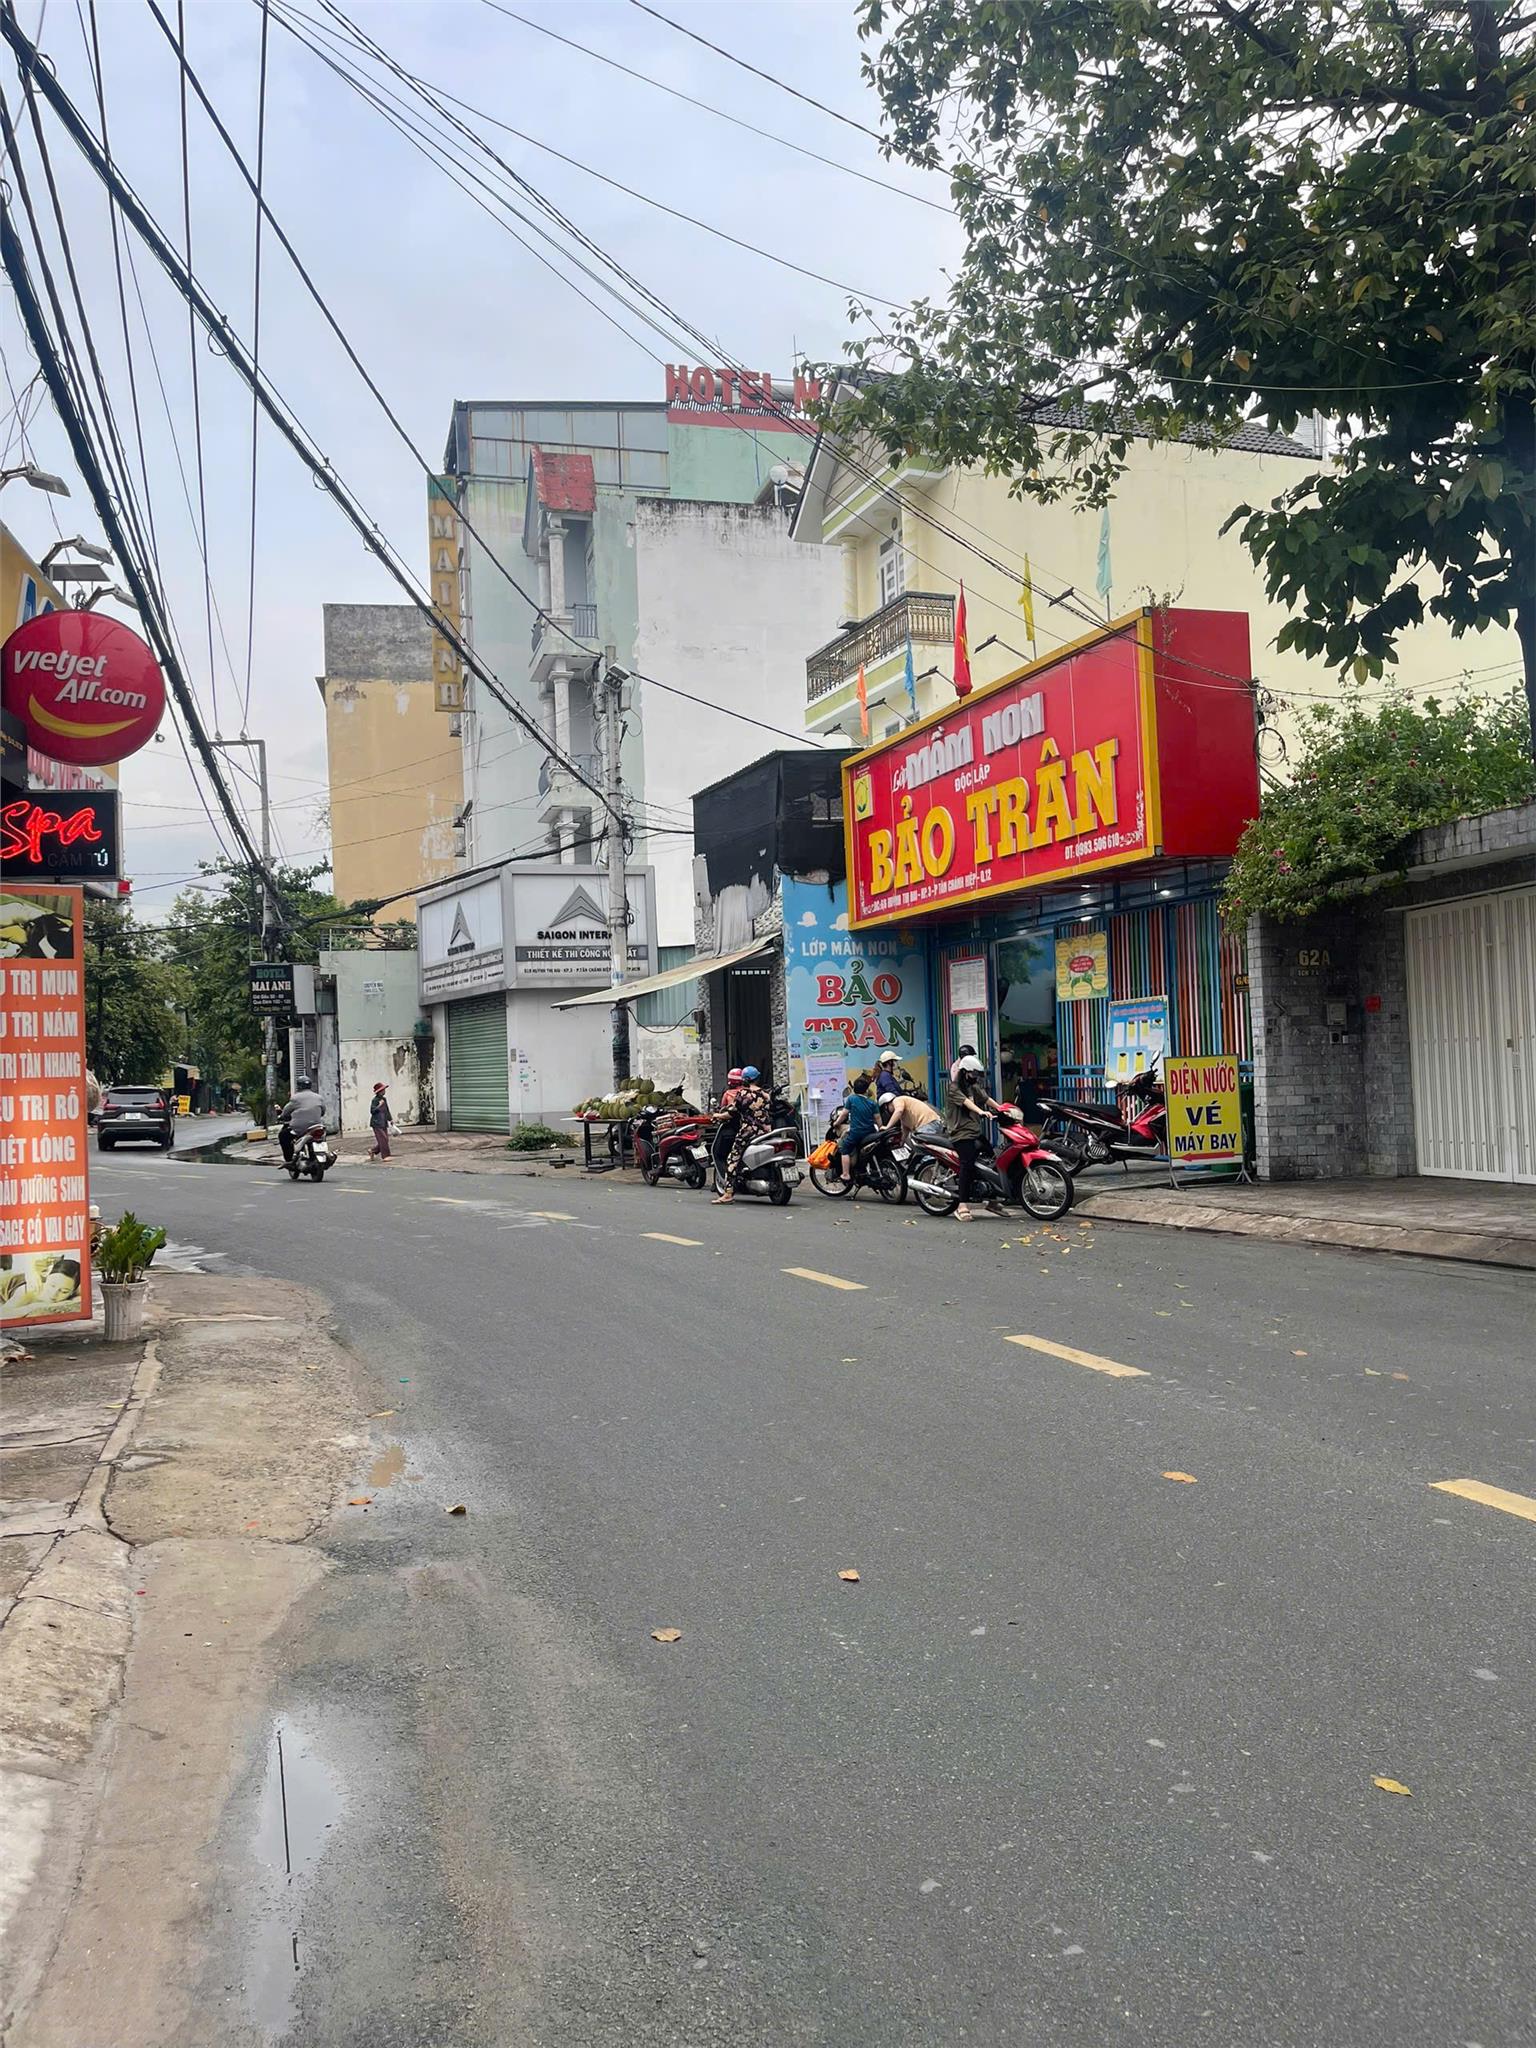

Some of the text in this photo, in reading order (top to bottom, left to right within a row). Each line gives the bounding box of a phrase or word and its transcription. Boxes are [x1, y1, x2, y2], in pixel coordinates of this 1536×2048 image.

[666, 364, 782, 412] HOTEL
[982, 691, 1045, 756] NON
[0, 800, 103, 863] Spa
[868, 737, 1119, 895] BẢO TRÂN
[537, 931, 577, 940] SAIGON
[802, 935, 898, 957] LỚP MẦM NON
[527, 947, 549, 959] THIẾT
[552, 947, 562, 959] KẾ
[565, 950, 578, 958] THI
[580, 948, 601, 958] CÔNG
[10, 969, 37, 1001] TRỊ
[42, 969, 78, 1001] MỤN
[815, 959, 903, 1007] BẢO
[11, 1011, 39, 1043] TRỊ
[43, 1007, 78, 1037] NÁM
[803, 1005, 915, 1048] TRÂN
[19, 1048, 41, 1079] TÀN
[44, 1052, 81, 1078] NHANG
[1170, 1060, 1236, 1100] ĐIỆN NƯỚC
[20, 1094, 50, 1126] TRỊ
[1186, 1100, 1222, 1126] VÉ
[31, 1131, 77, 1164] LÔNG
[1175, 1131, 1237, 1152] MÁY BAY
[60, 1175, 86, 1203] SINH
[27, 1208, 43, 1246] CỔ
[45, 1216, 62, 1243] VAI
[64, 1212, 86, 1242] GÁY
